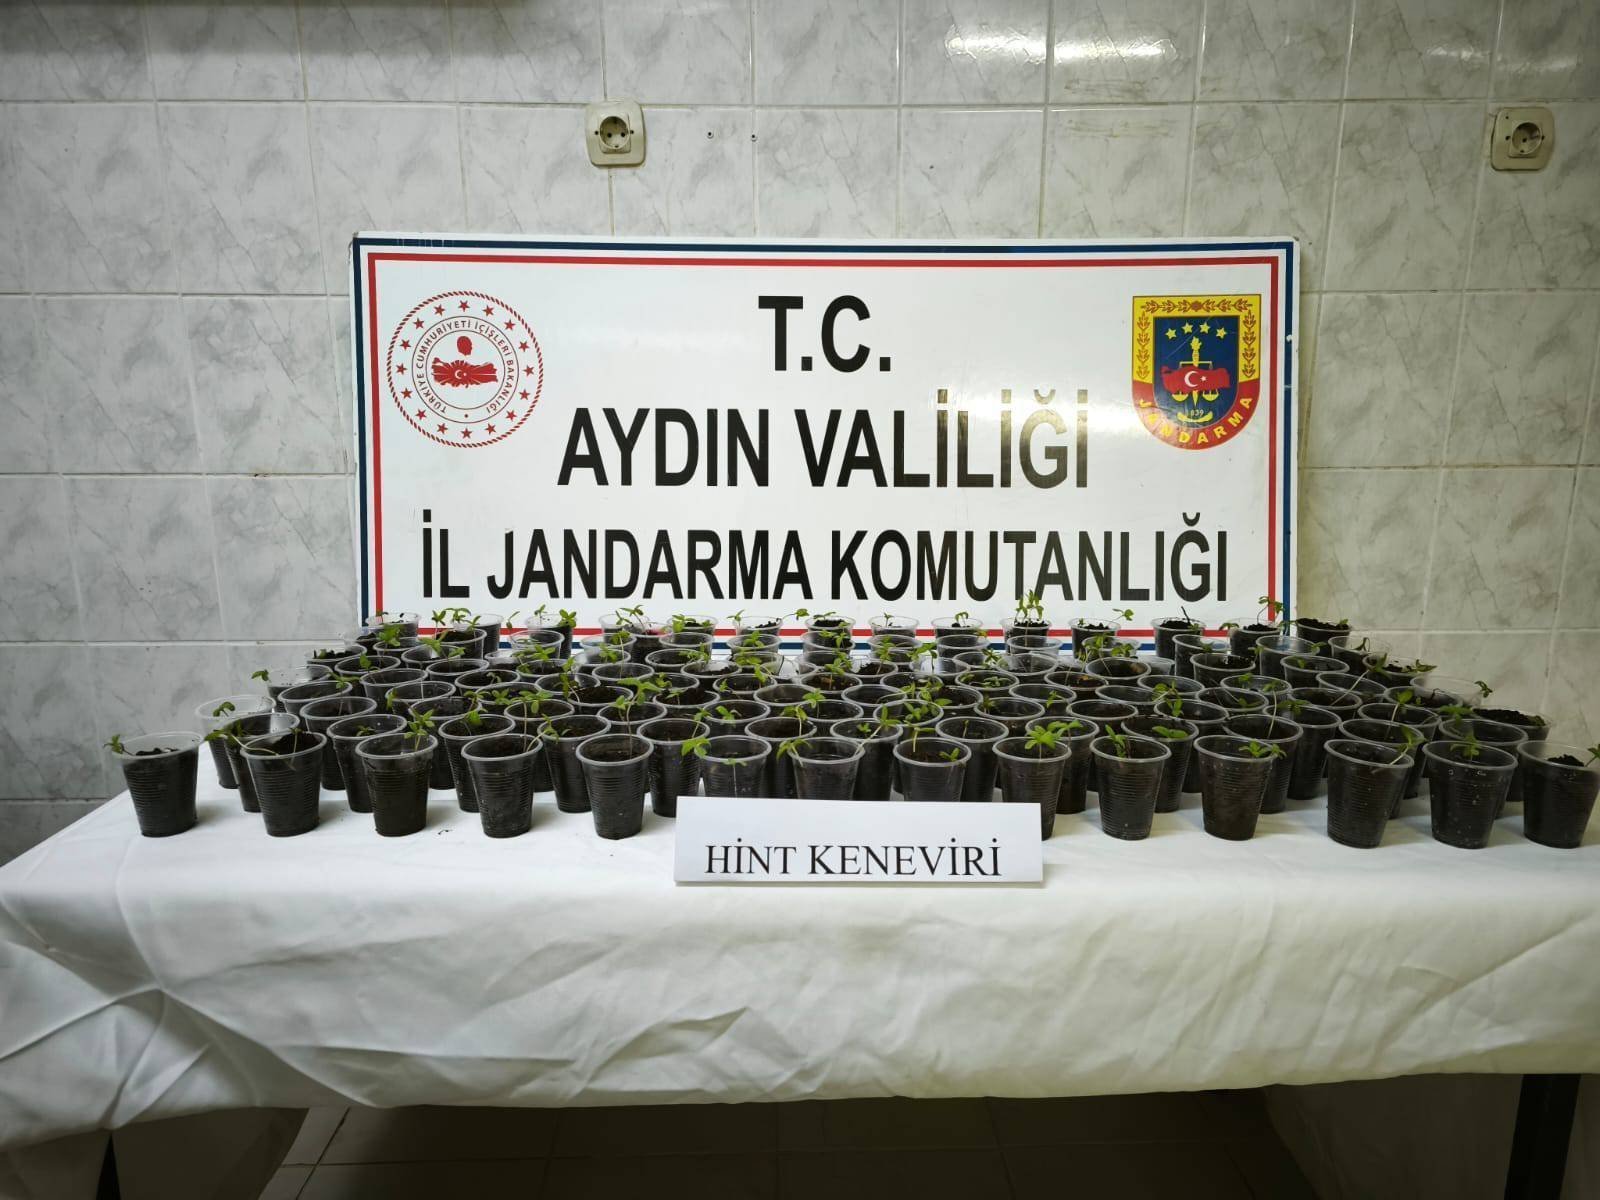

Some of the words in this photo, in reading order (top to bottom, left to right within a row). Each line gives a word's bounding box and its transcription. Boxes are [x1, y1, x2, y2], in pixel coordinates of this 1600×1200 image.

[416, 320, 471, 369] CUMHURİYETİ
[474, 321, 513, 357] İÇİŞLERİ
[758, 295, 891, 373] T.C.
[557, 407, 769, 487] AYDIN
[794, 388, 1088, 489] VALİLİĞİ
[1139, 397, 1253, 444] JANDARMA
[422, 509, 470, 599] İL
[486, 528, 814, 600] JANDARMA
[830, 512, 1228, 602] KOMUTANLIĞI
[704, 837, 797, 875] HİNT
[807, 837, 1003, 876] KENEVİRİ
